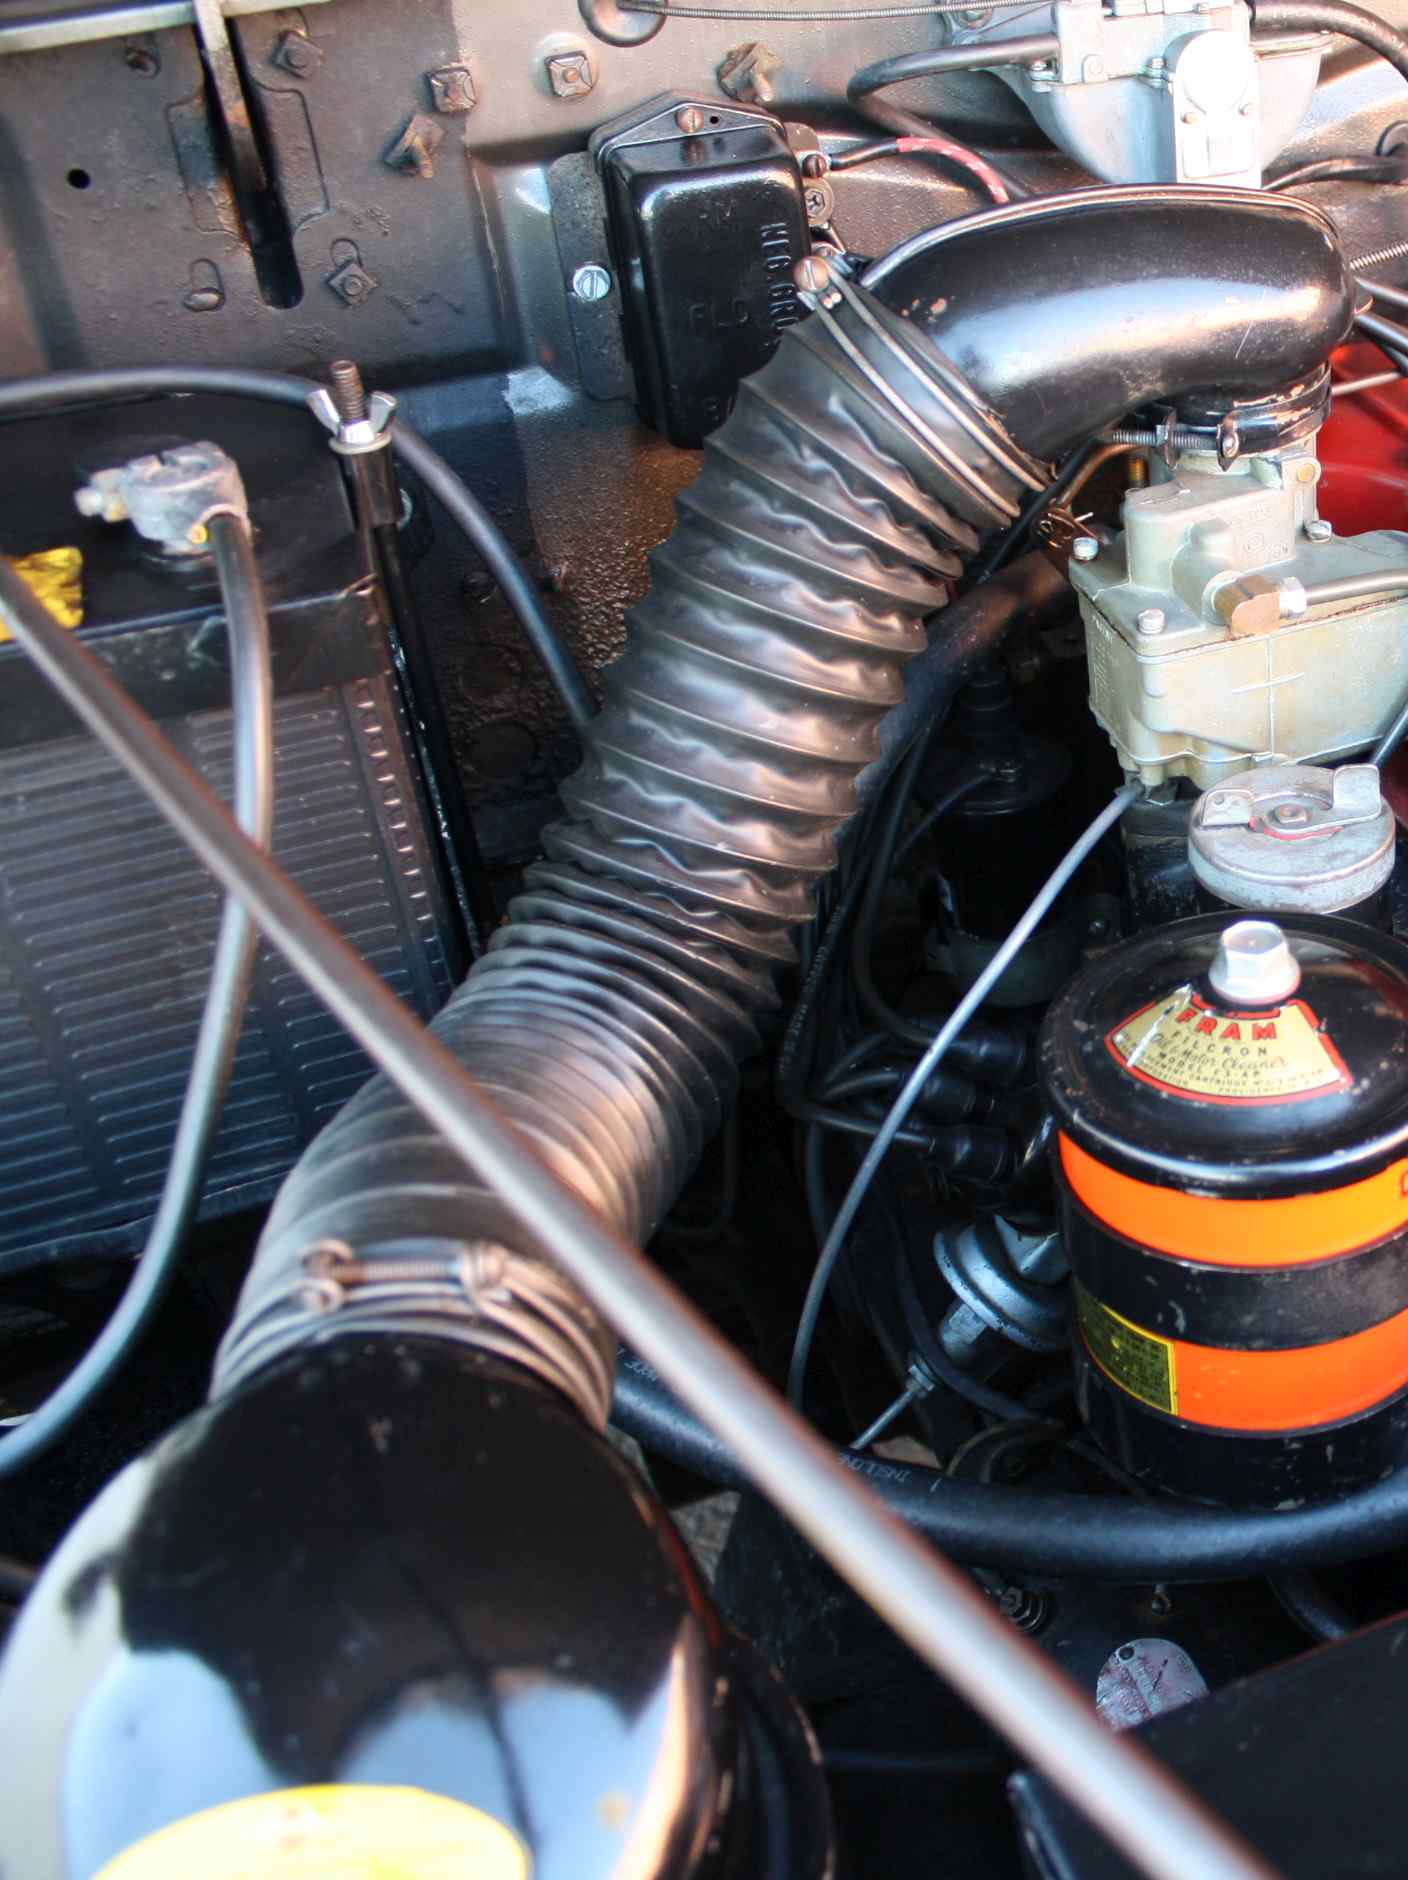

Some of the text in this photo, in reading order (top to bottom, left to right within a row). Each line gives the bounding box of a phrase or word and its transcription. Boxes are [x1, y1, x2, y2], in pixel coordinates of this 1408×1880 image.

[1175, 1007, 1277, 1041] FRAM
[1170, 1030, 1268, 1057] FILCRON
[1158, 1051, 1203, 1073] MODEL
